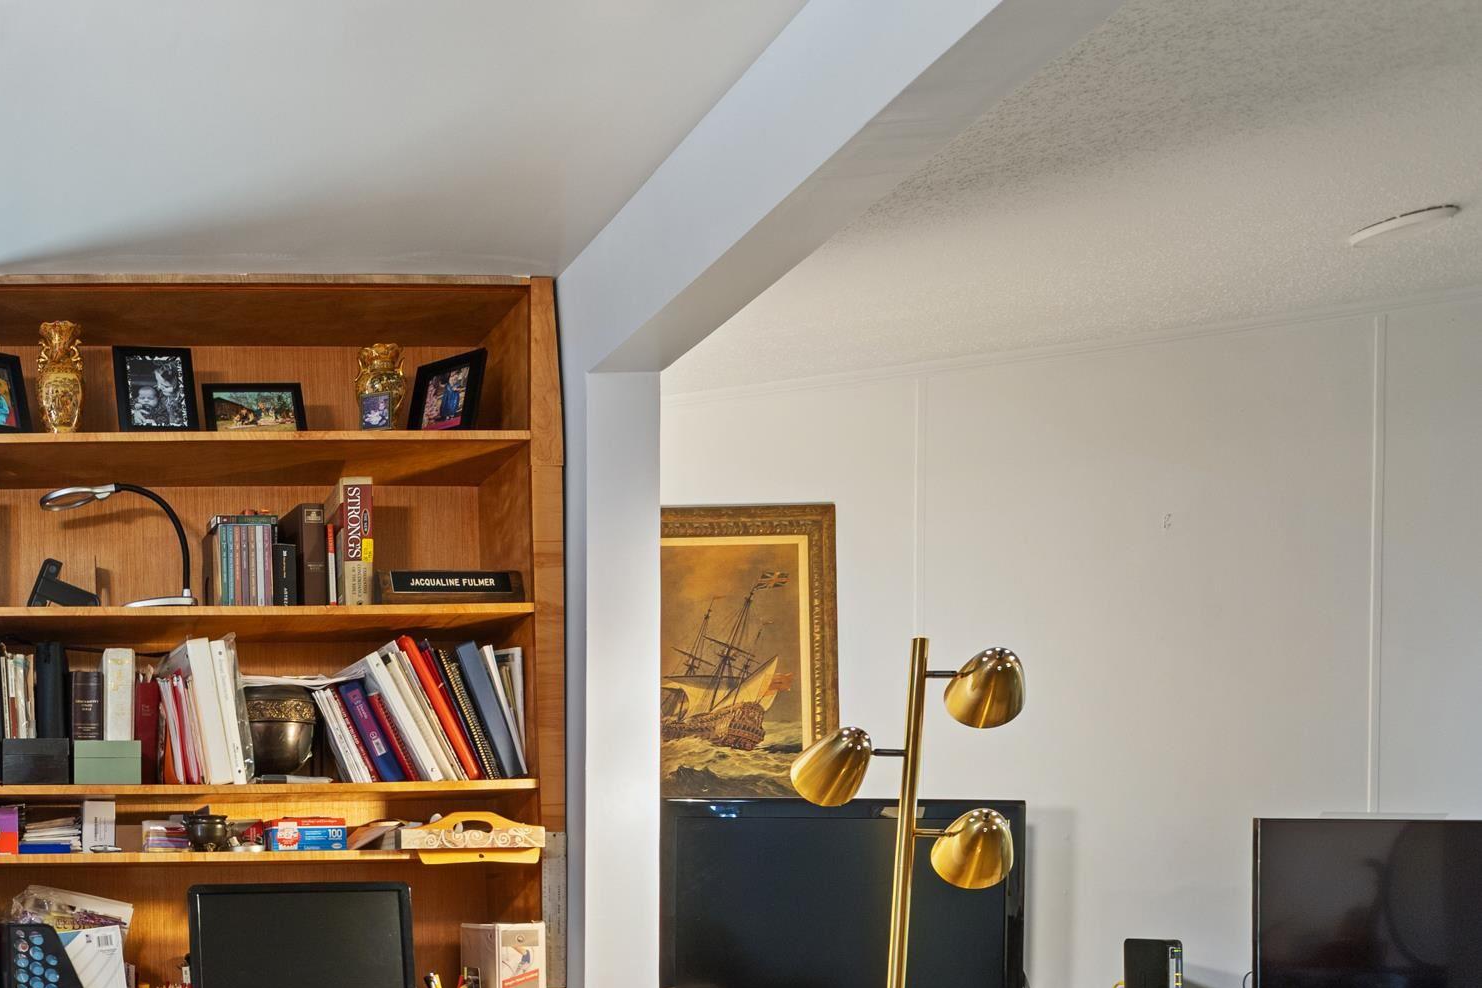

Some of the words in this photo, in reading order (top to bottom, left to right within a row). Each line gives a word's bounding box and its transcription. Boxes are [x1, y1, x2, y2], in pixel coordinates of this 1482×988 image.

[347, 487, 361, 559] STRONG'S
[410, 578, 460, 587] JACQUALINE
[462, 578, 495, 586] FULMER
[328, 829, 342, 838] 100
